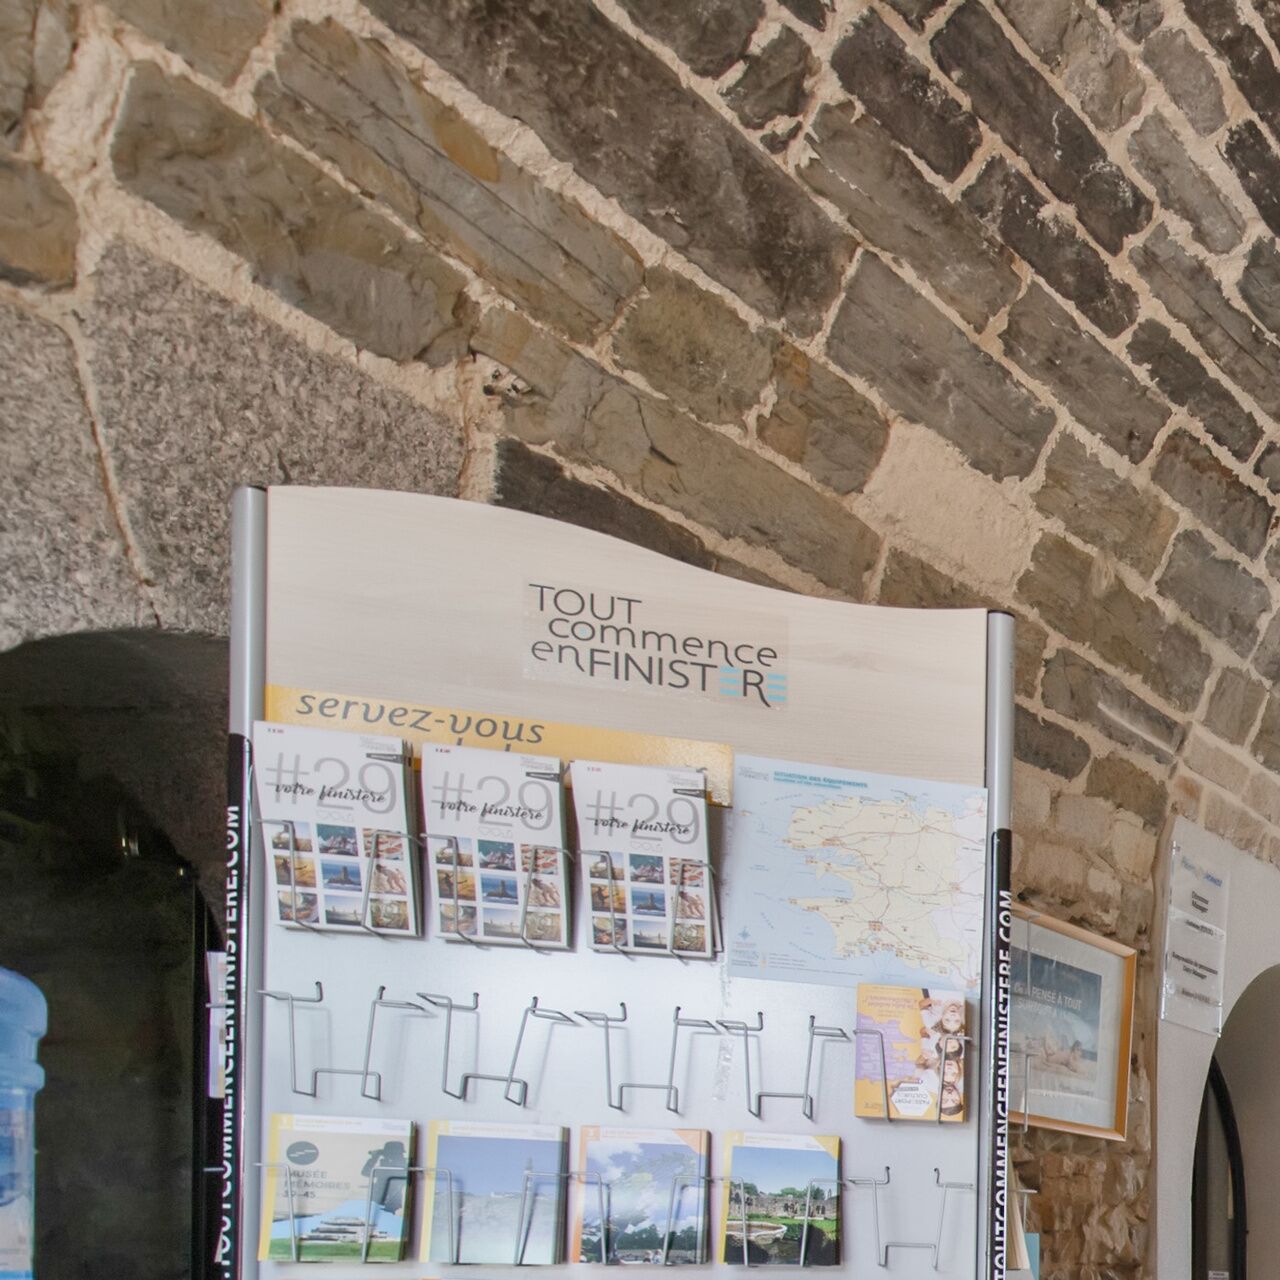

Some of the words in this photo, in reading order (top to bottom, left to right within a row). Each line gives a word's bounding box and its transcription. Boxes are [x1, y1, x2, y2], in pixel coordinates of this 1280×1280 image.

[528, 582, 643, 625] TOUT
[548, 616, 778, 668] commence
[295, 691, 546, 745] servez-vous
[265, 751, 399, 815] #29
[275, 782, 315, 797] votre
[431, 770, 555, 831] #29
[440, 800, 477, 815] votre
[585, 789, 700, 845] #29
[594, 816, 628, 829] votre
